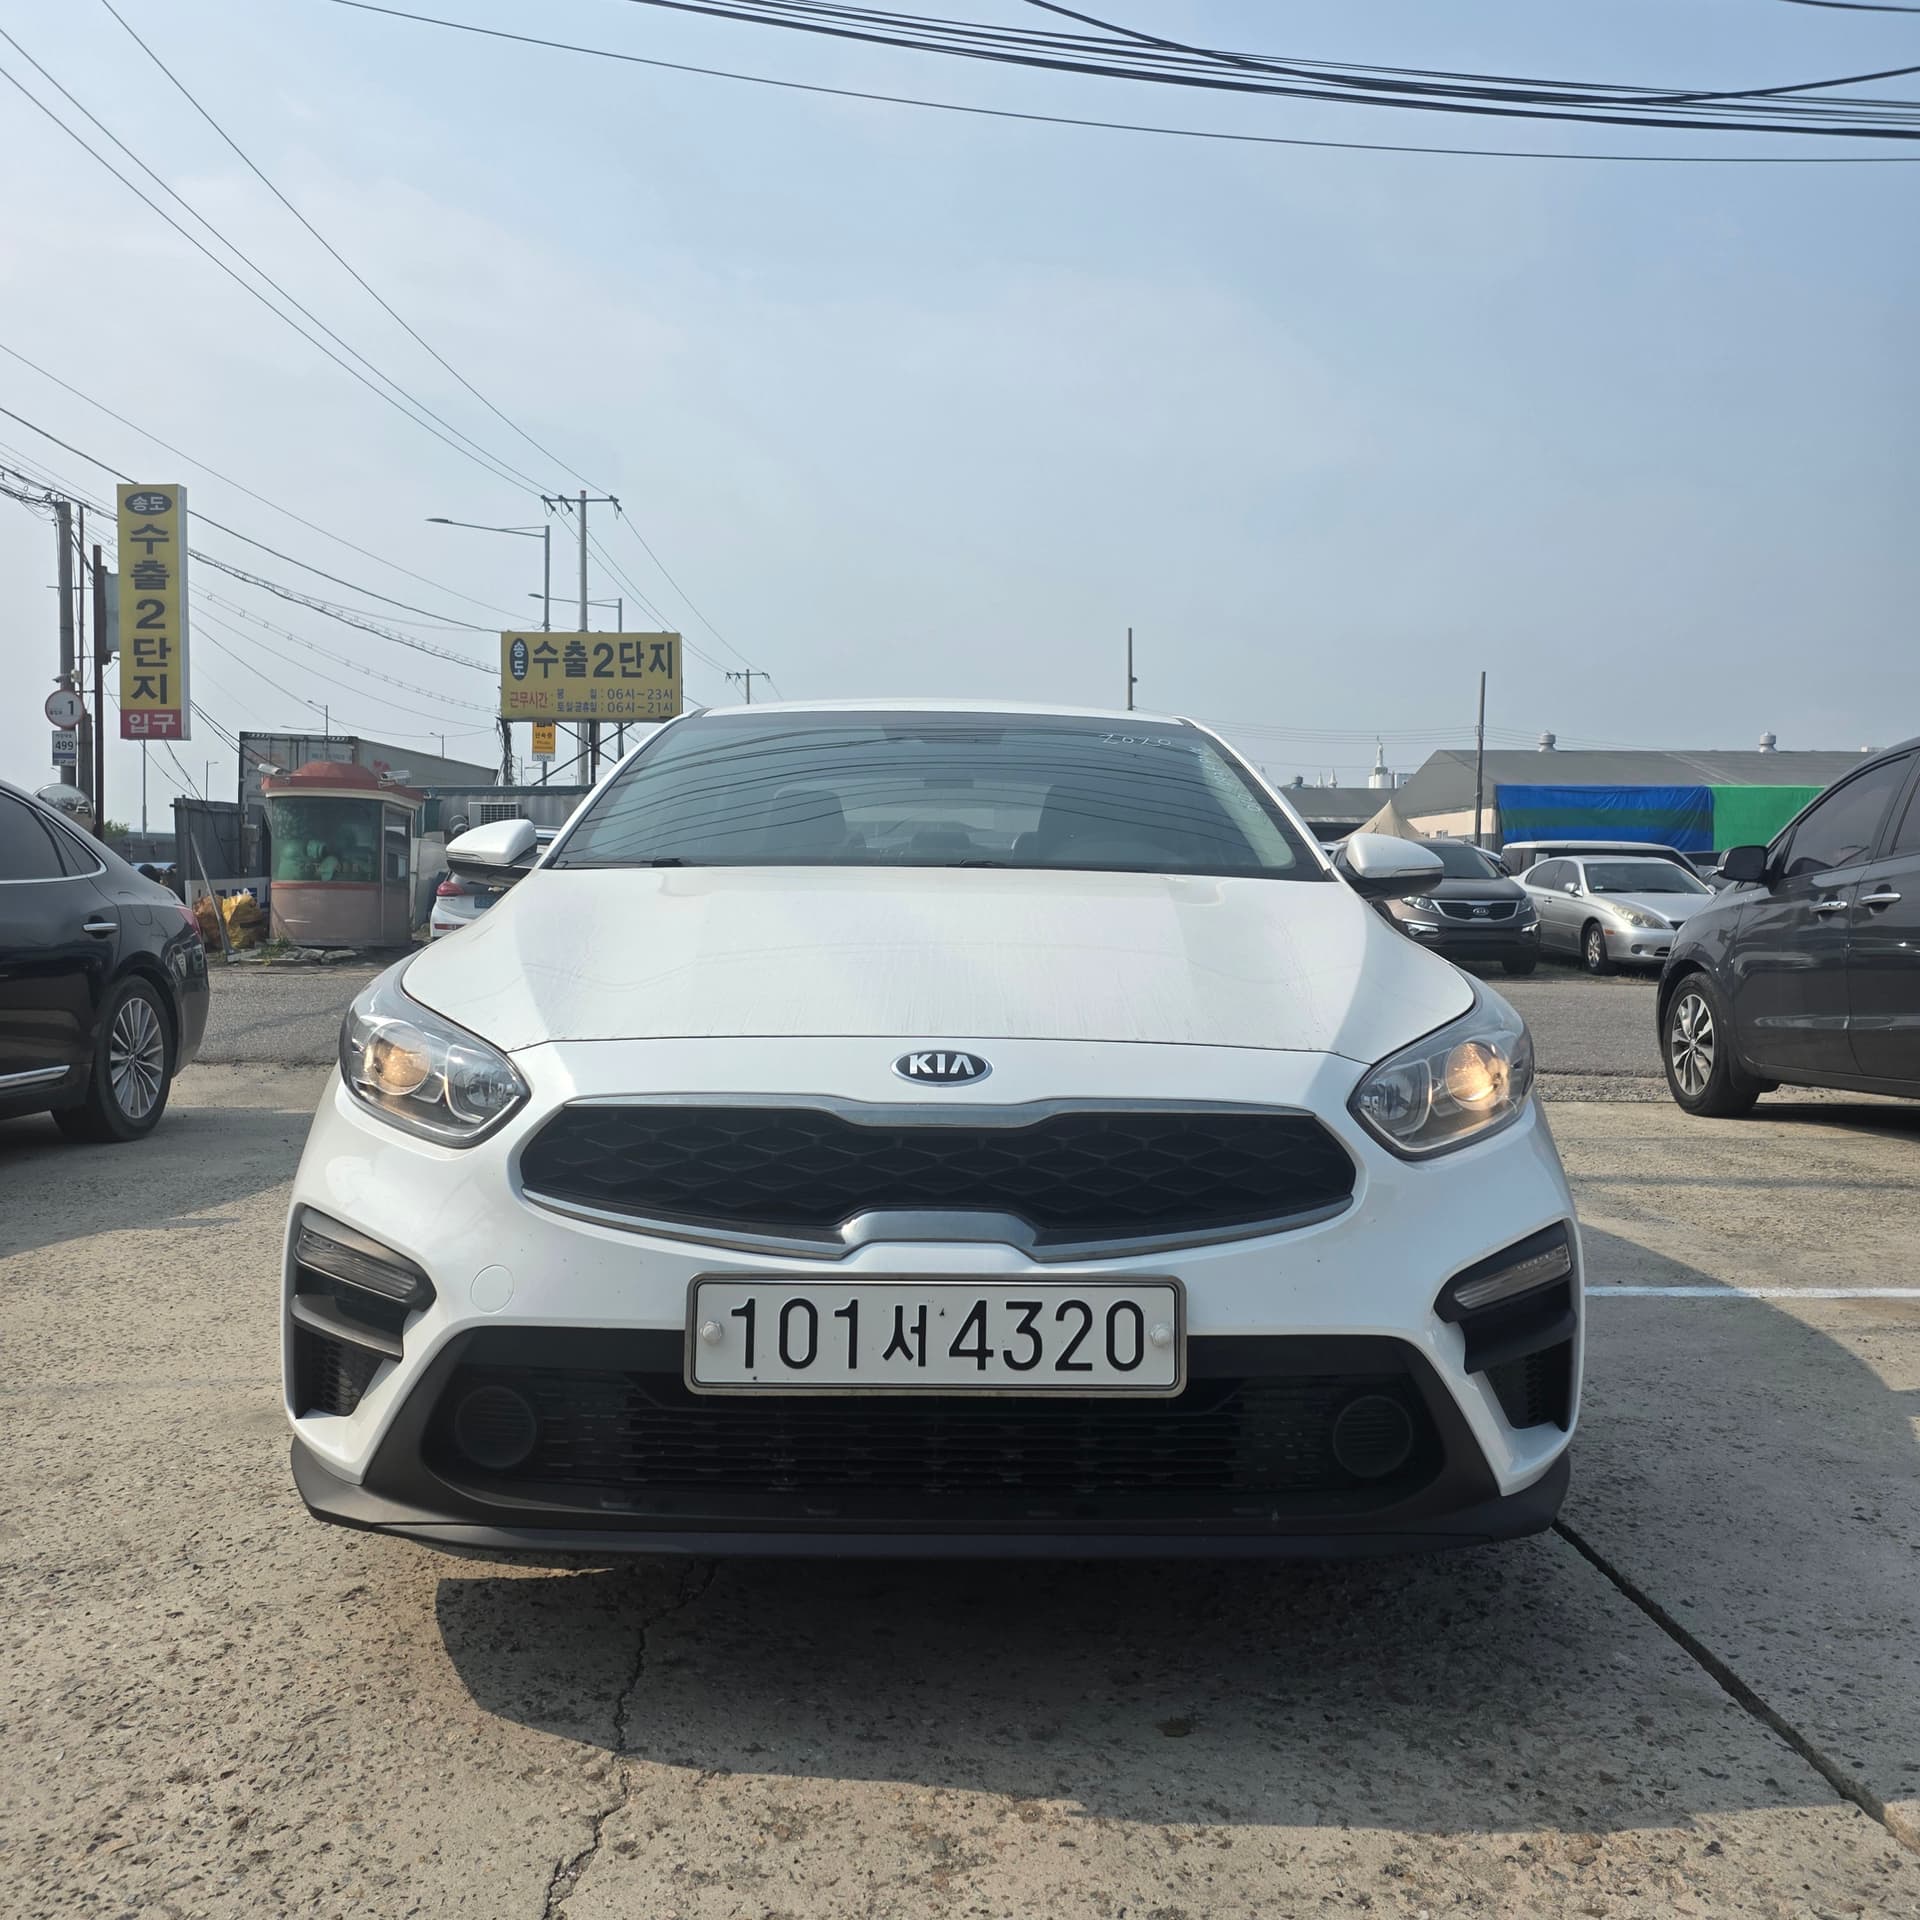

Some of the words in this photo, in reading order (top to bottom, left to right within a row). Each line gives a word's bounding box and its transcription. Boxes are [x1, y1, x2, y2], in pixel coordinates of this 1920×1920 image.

[132, 495, 166, 512] 송도
[130, 523, 171, 705] 수출2단지
[513, 641, 526, 676] 송도
[532, 640, 673, 680] 수출2단지
[67, 700, 75, 716] 1
[128, 713, 176, 734] 입구
[55, 740, 74, 751] 499
[909, 1053, 975, 1075] KIA
